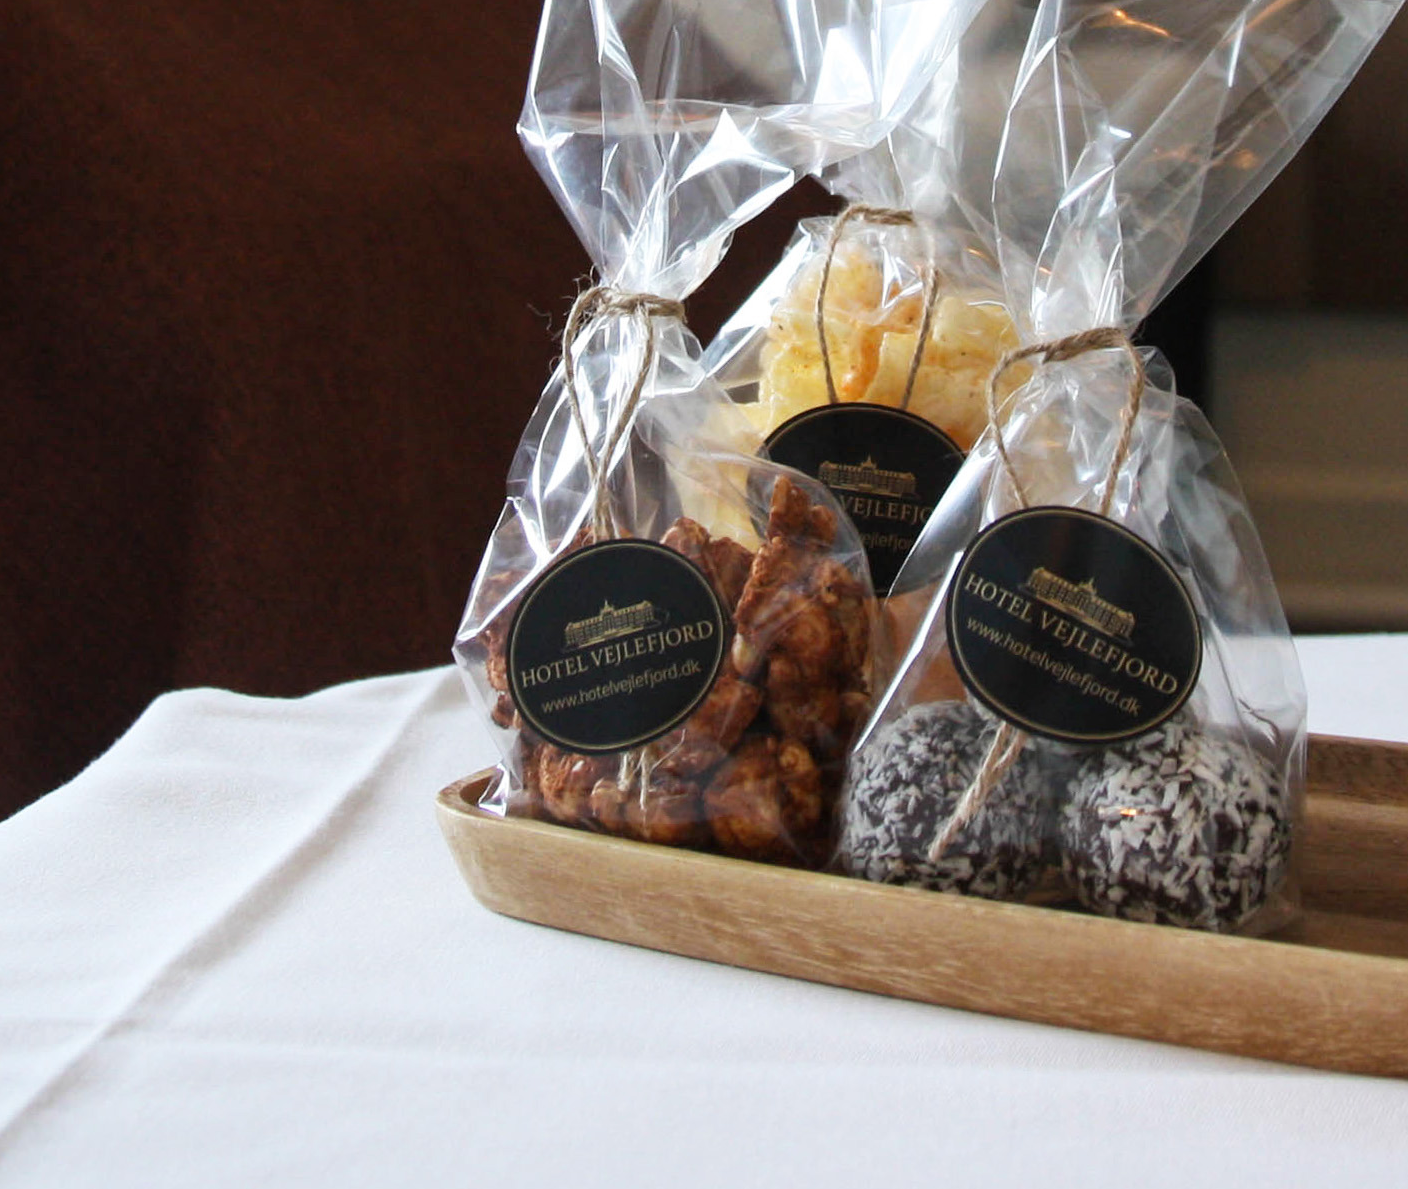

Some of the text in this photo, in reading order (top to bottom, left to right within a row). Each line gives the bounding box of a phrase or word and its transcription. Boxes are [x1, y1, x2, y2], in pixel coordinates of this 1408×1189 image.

[521, 619, 714, 689] HOTEL VEJLEFJORD
[964, 573, 1178, 696] HOTEL VEJLEFJORD
[966, 615, 1140, 717] www.hotelvejlefjord.dk
[542, 659, 702, 714] www.hotelvejlefjord.dk
